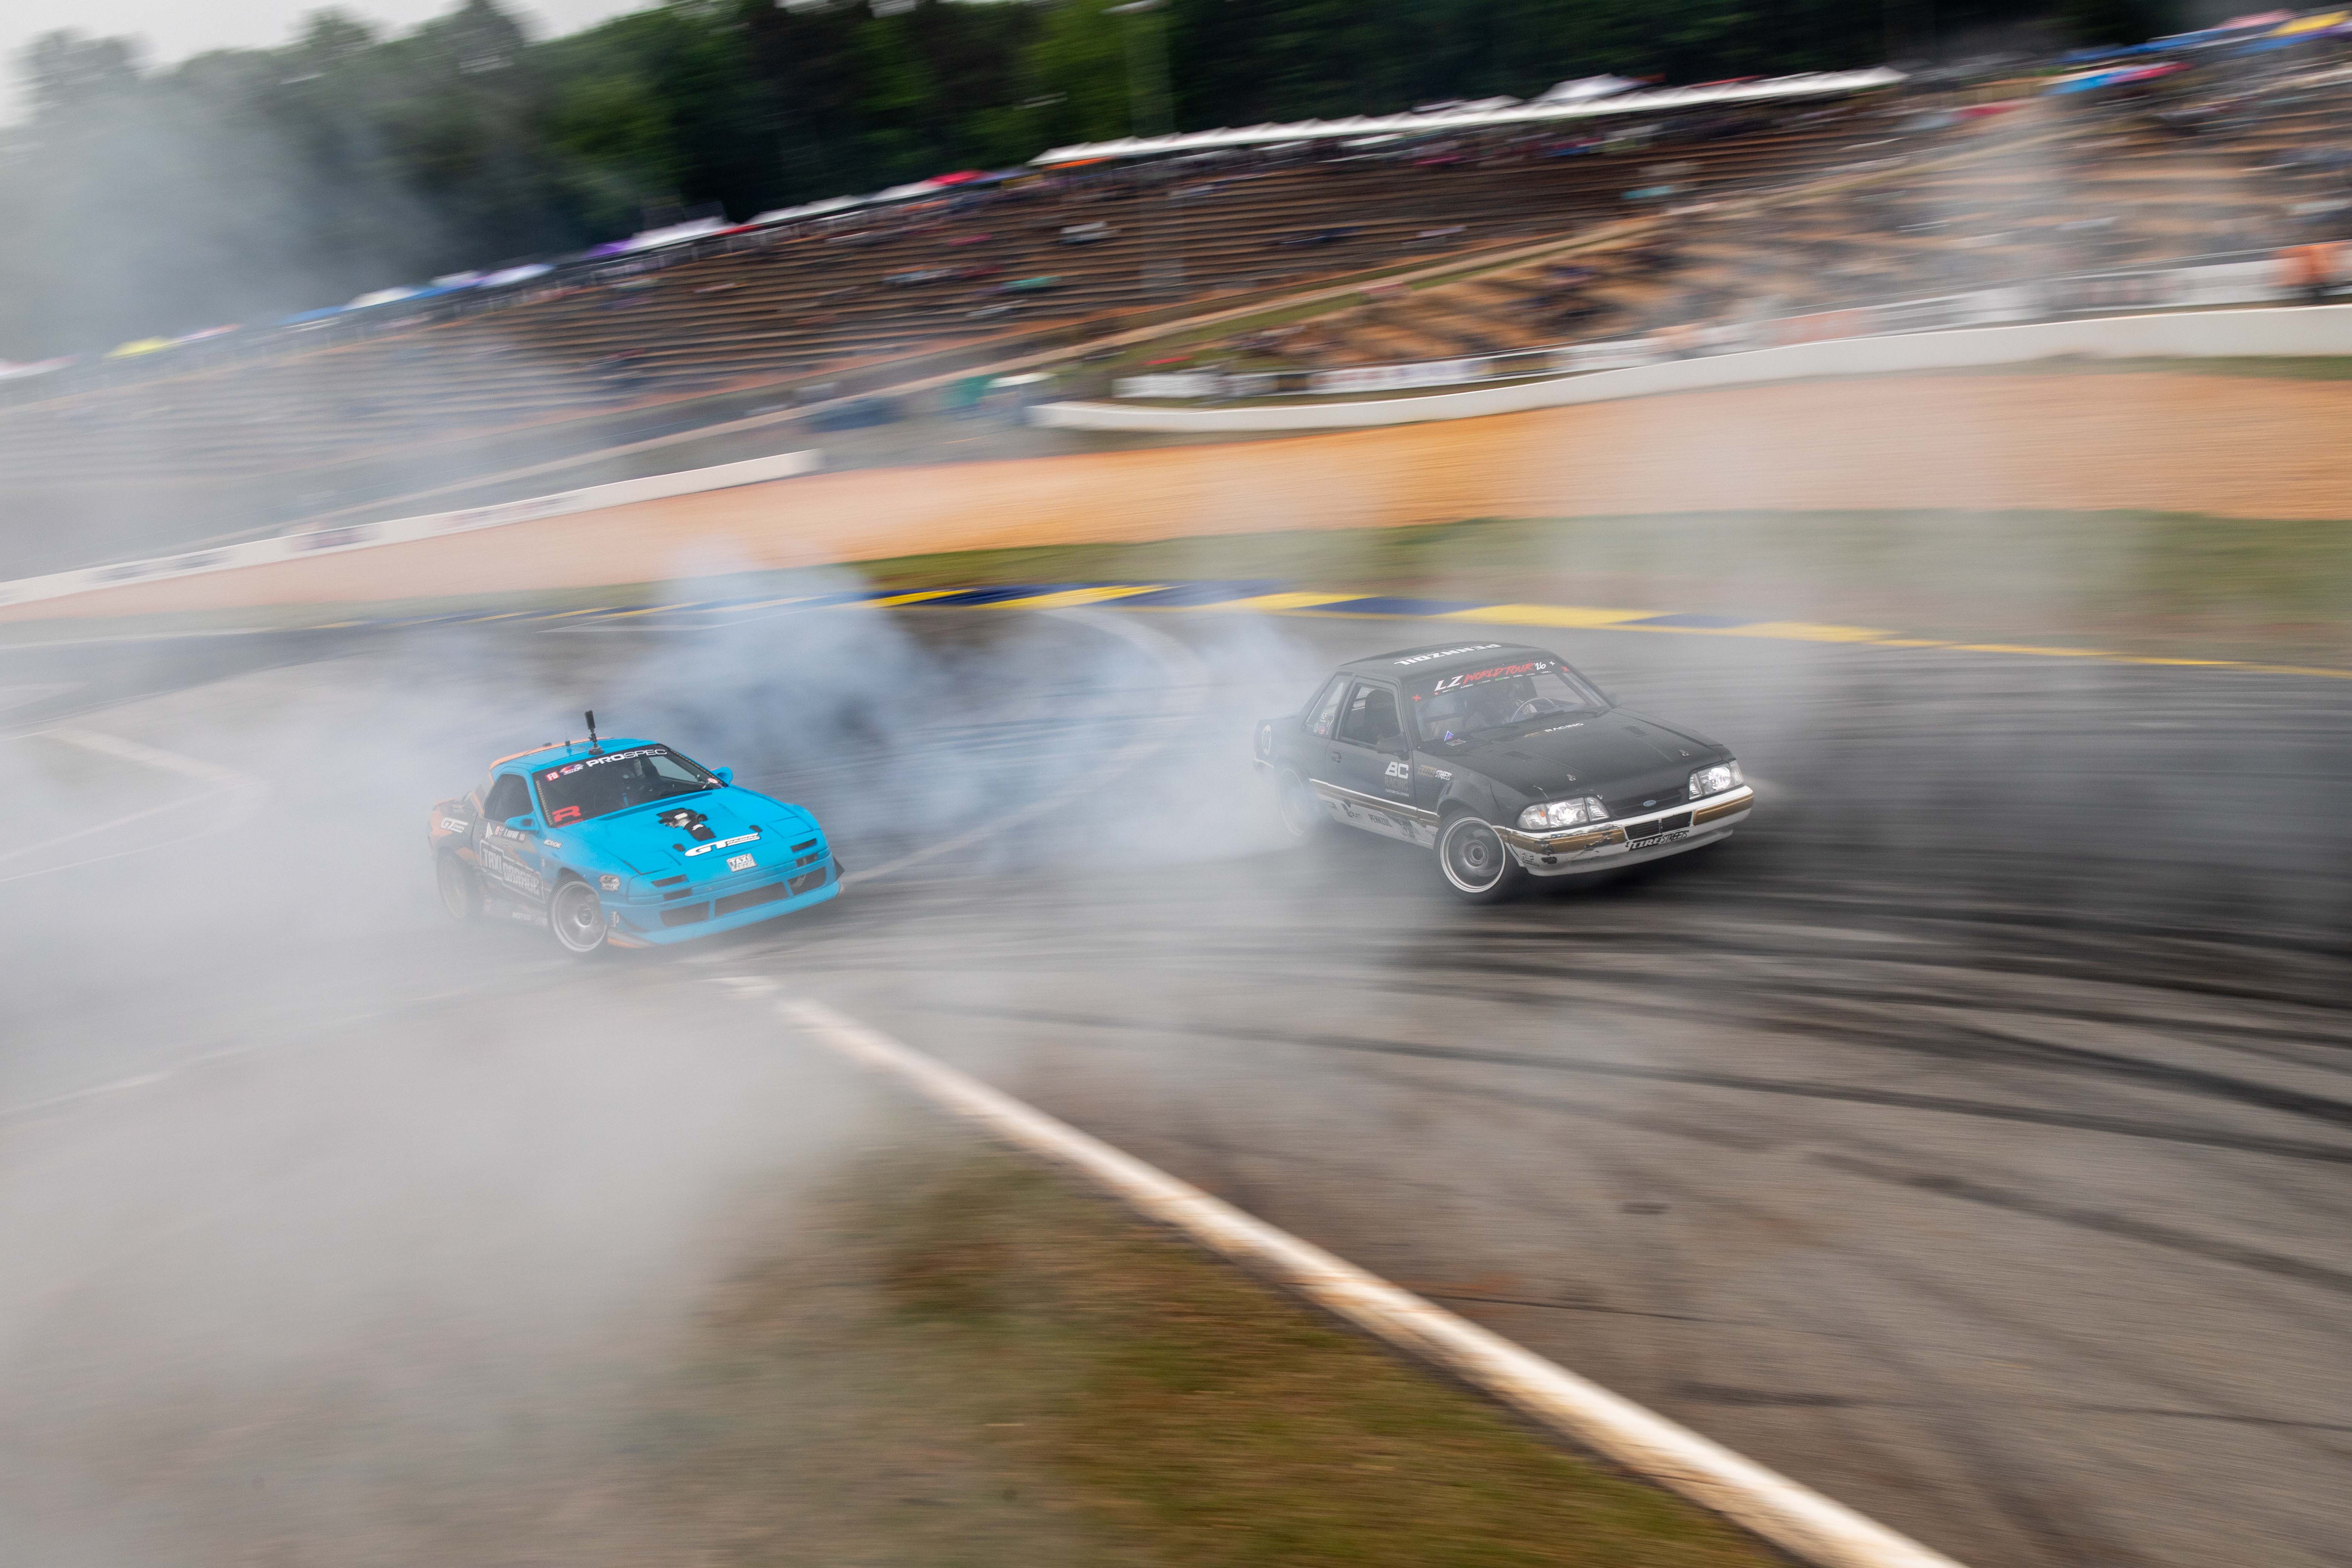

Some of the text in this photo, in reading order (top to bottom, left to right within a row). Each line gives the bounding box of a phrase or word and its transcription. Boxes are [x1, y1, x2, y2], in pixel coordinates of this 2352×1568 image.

[1394, 644, 1502, 665] PENNZOIL
[1434, 675, 1464, 691] LZ
[1462, 668, 1504, 684] WORLD
[1503, 663, 1535, 675] TOUR
[1545, 723, 1584, 732] RACING
[586, 749, 667, 767] PROSPEC
[1385, 761, 1409, 779] BC
[482, 848, 503, 874] TAXI
[727, 853, 754, 868] TAXI
